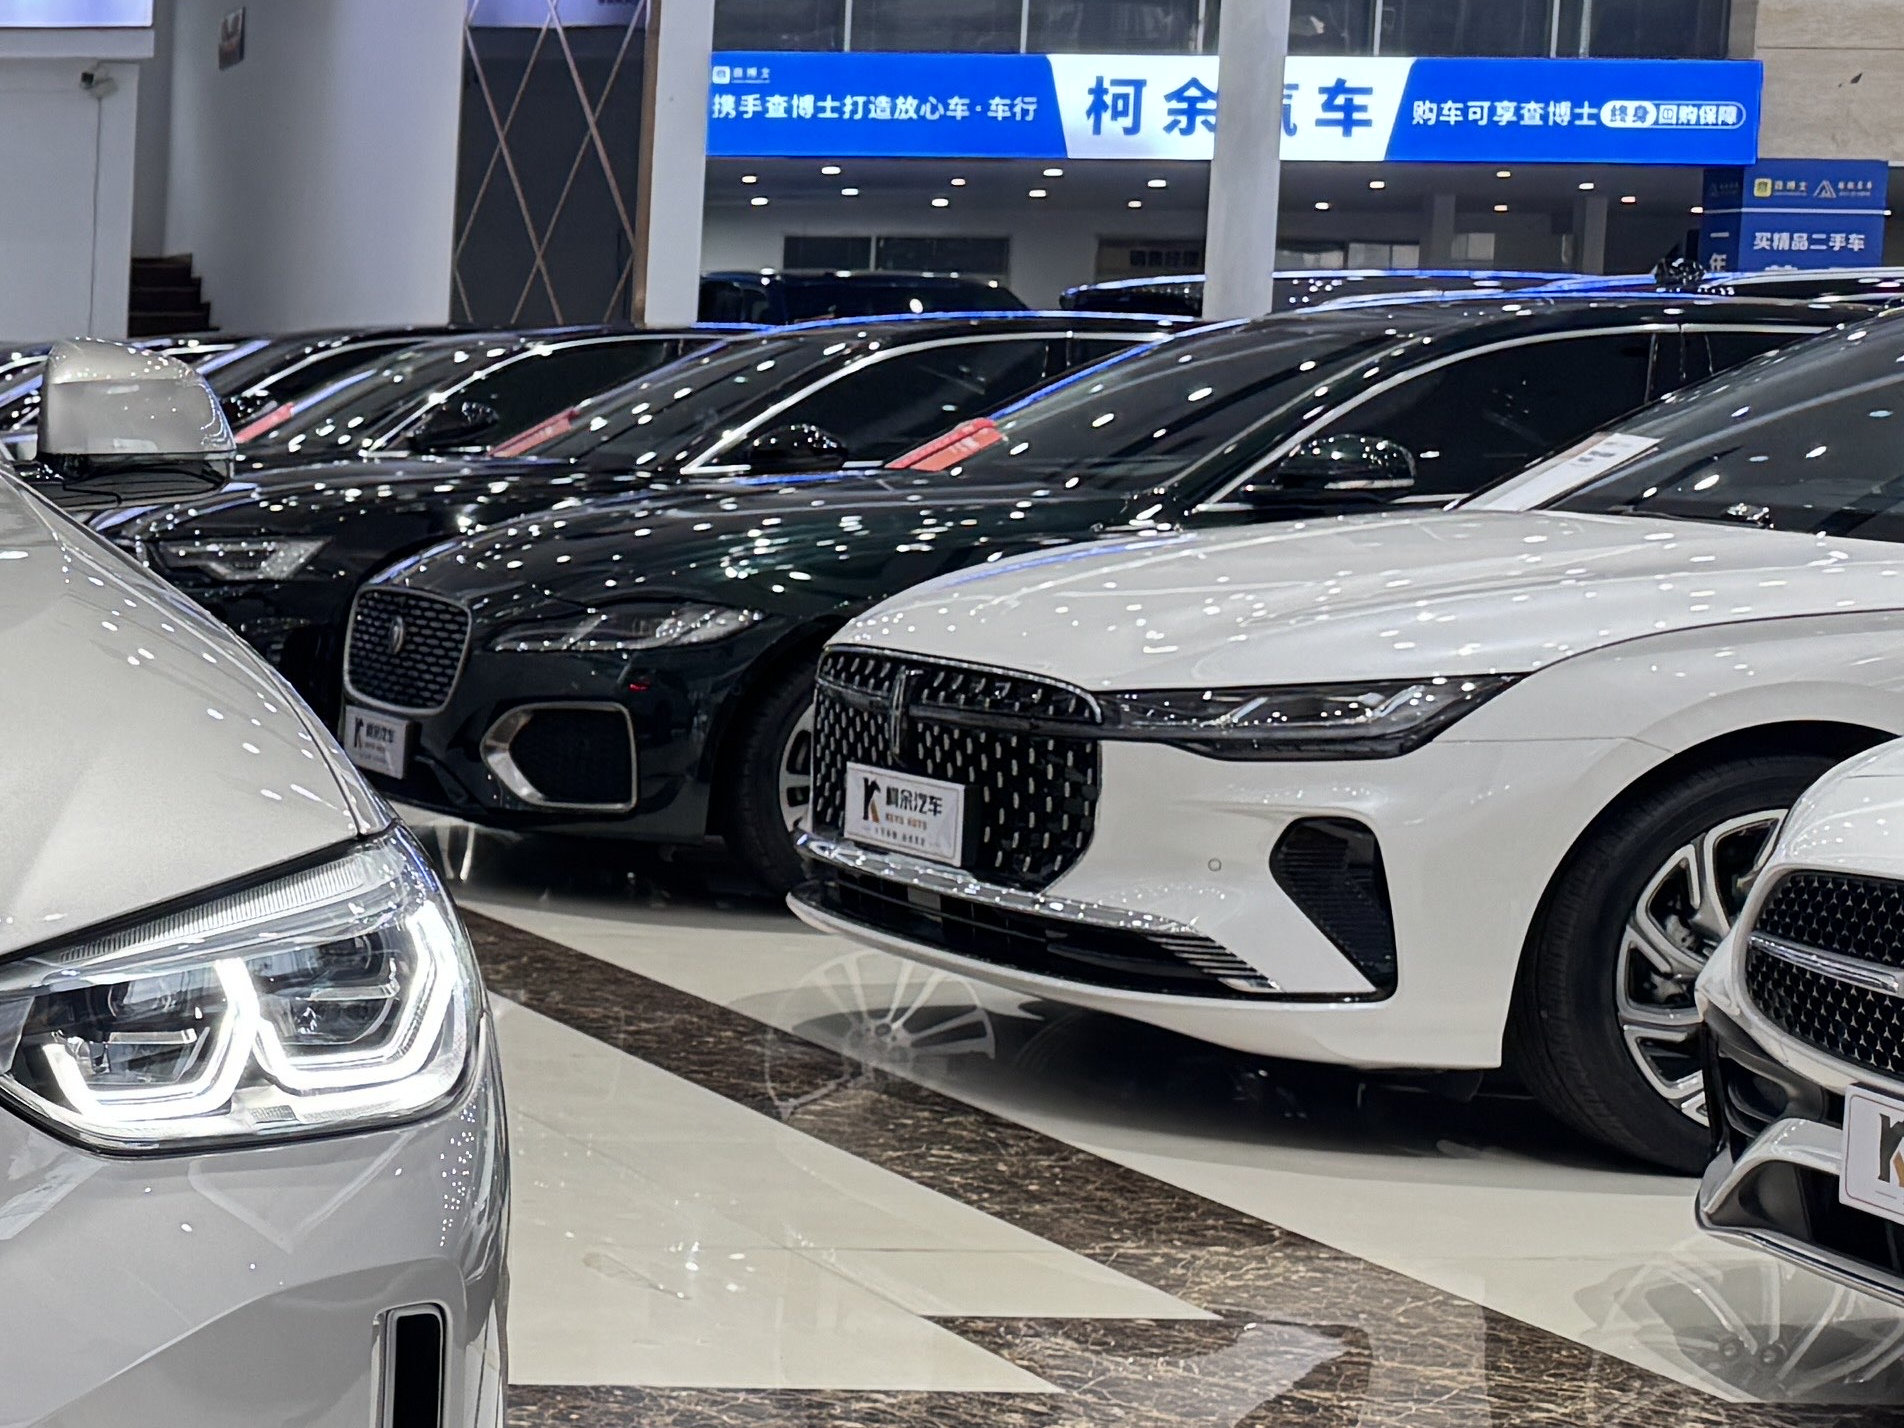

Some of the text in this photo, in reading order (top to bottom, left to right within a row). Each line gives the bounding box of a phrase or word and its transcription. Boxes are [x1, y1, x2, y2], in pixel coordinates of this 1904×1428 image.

[1412, 100, 1599, 126] 购车可享查博士
[1658, 104, 1738, 125] 回购保障
[1753, 232, 1866, 252] 买精品二手车
